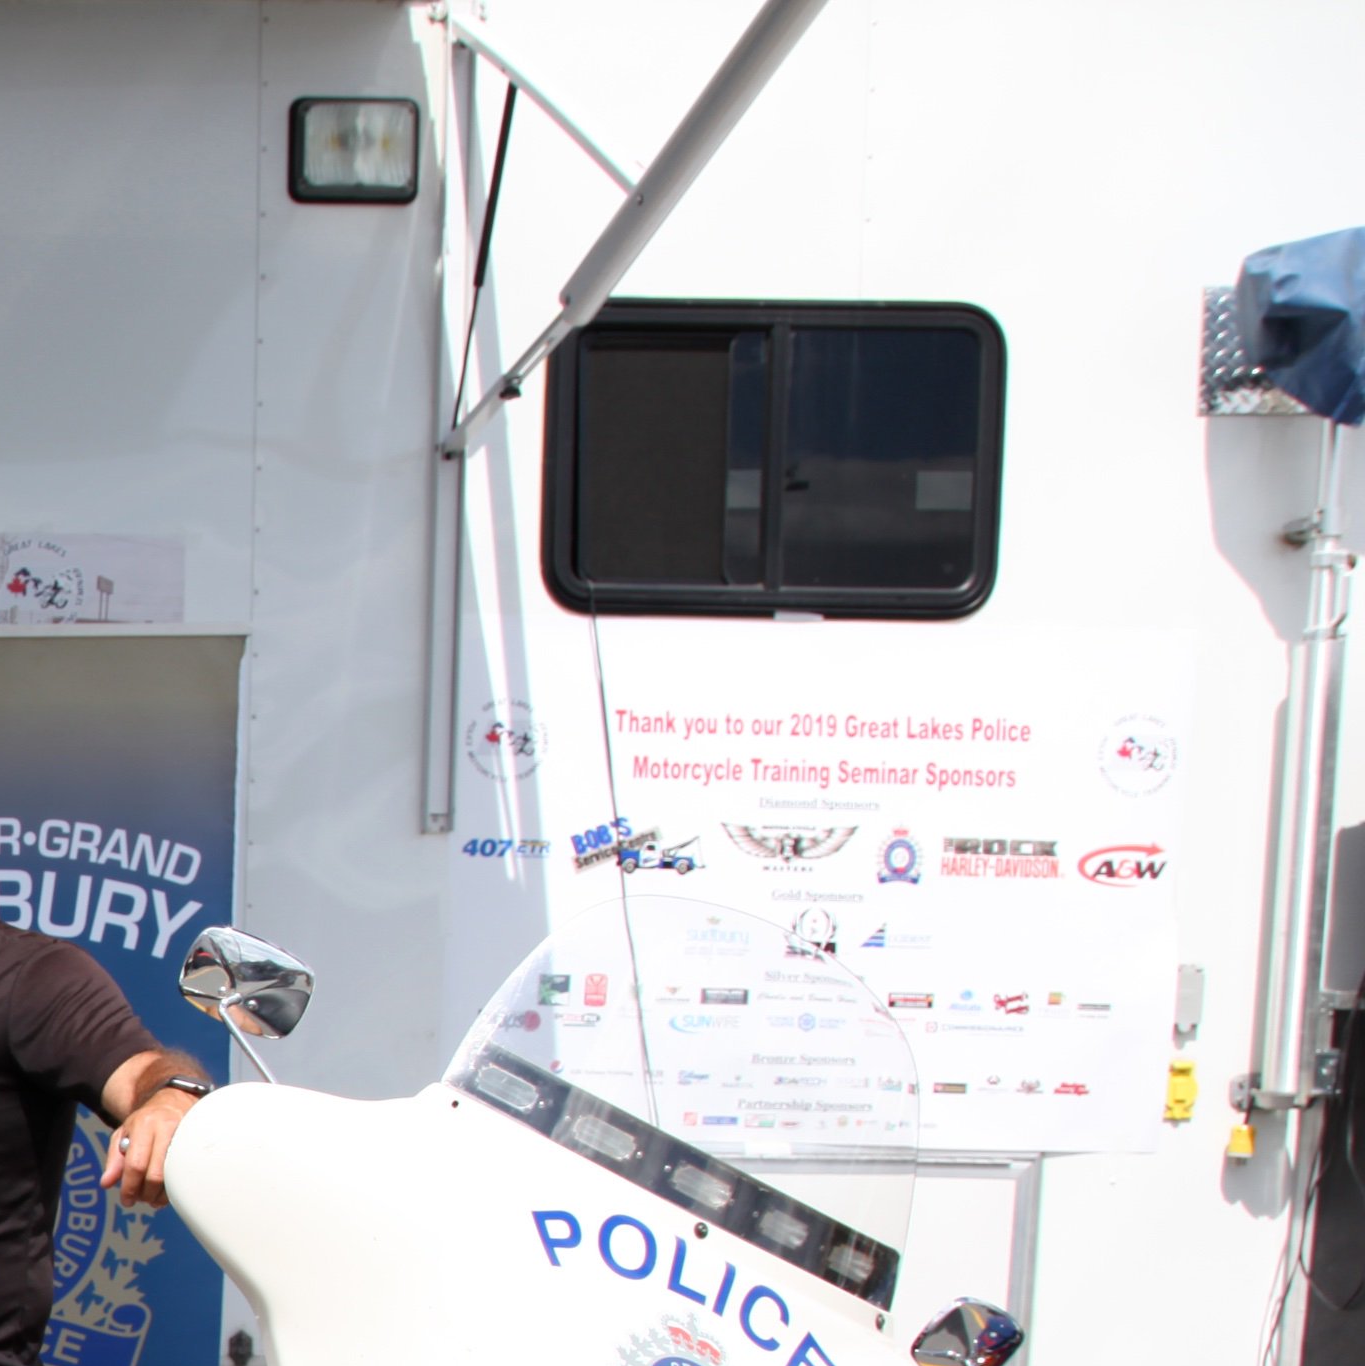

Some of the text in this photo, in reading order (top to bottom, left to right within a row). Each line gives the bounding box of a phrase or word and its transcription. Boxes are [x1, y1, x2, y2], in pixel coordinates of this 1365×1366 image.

[614, 708, 1031, 743] Thank you to our 2019 Great Lakes Police
[632, 755, 1017, 792] Motorcycle Training Seminar Sponsors
[759, 796, 880, 811] Diamond Sponsors
[571, 816, 633, 856] BOB'S
[461, 837, 514, 858] 407
[953, 837, 1060, 858] ROCK
[939, 855, 1061, 881] HARLEY-DAVIDSON
[1091, 858, 1168, 881] A&W
[771, 889, 865, 904] Gold Sponsors
[682, 1013, 741, 1029] SUNWIRE
[750, 1052, 857, 1067] Bronze Sponsors
[737, 1097, 874, 1113] Partnership Sponsors
[54, 1141, 99, 1291] SUDBUR
